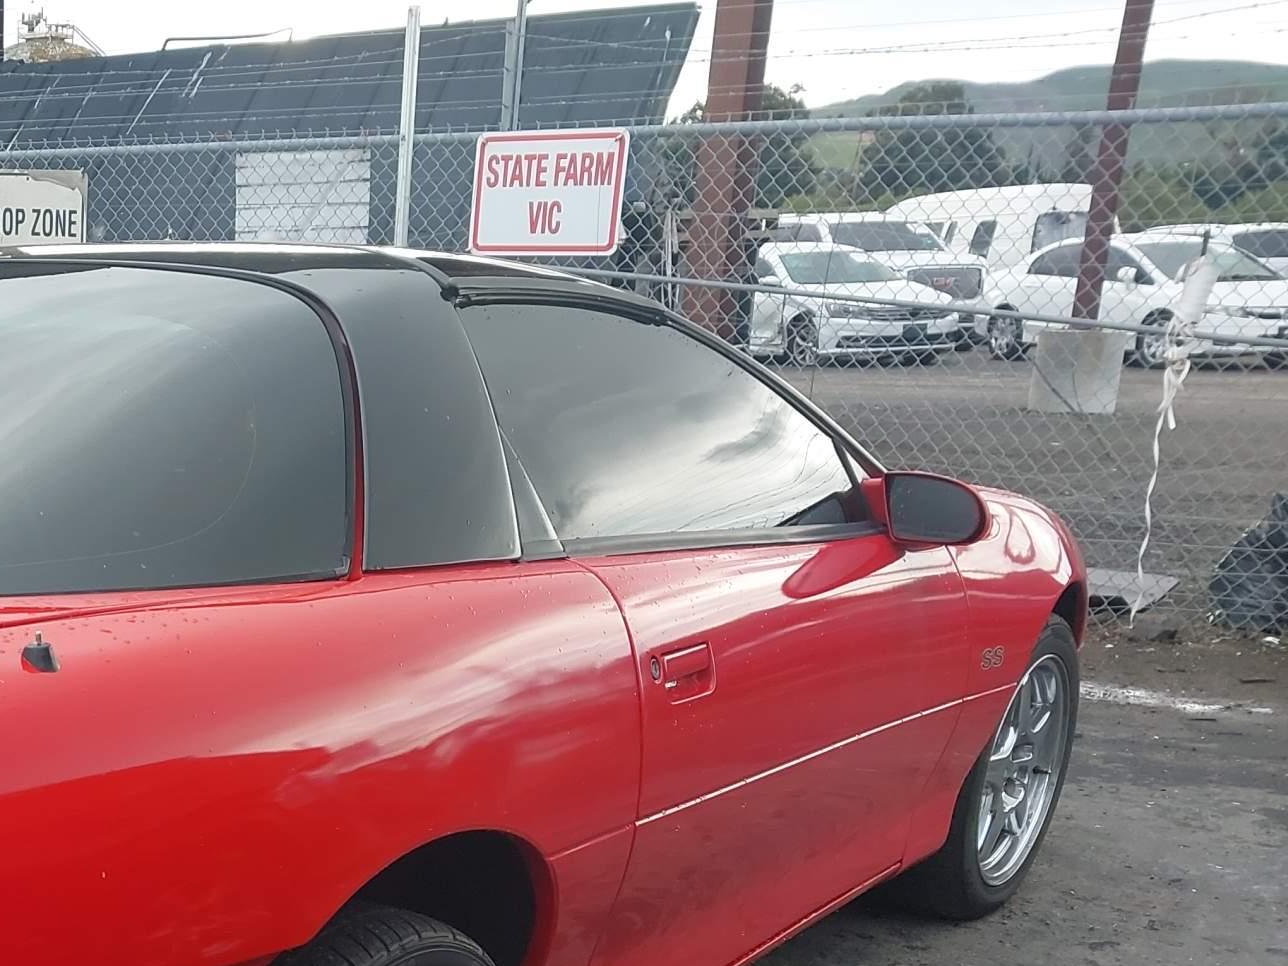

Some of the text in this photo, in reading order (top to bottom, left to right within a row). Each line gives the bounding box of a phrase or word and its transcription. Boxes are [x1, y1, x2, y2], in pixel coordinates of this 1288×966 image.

[486, 151, 615, 188] STATE FARM
[31, 208, 78, 238] ZONE
[528, 200, 562, 234] VIC
[980, 645, 1005, 671] SS
